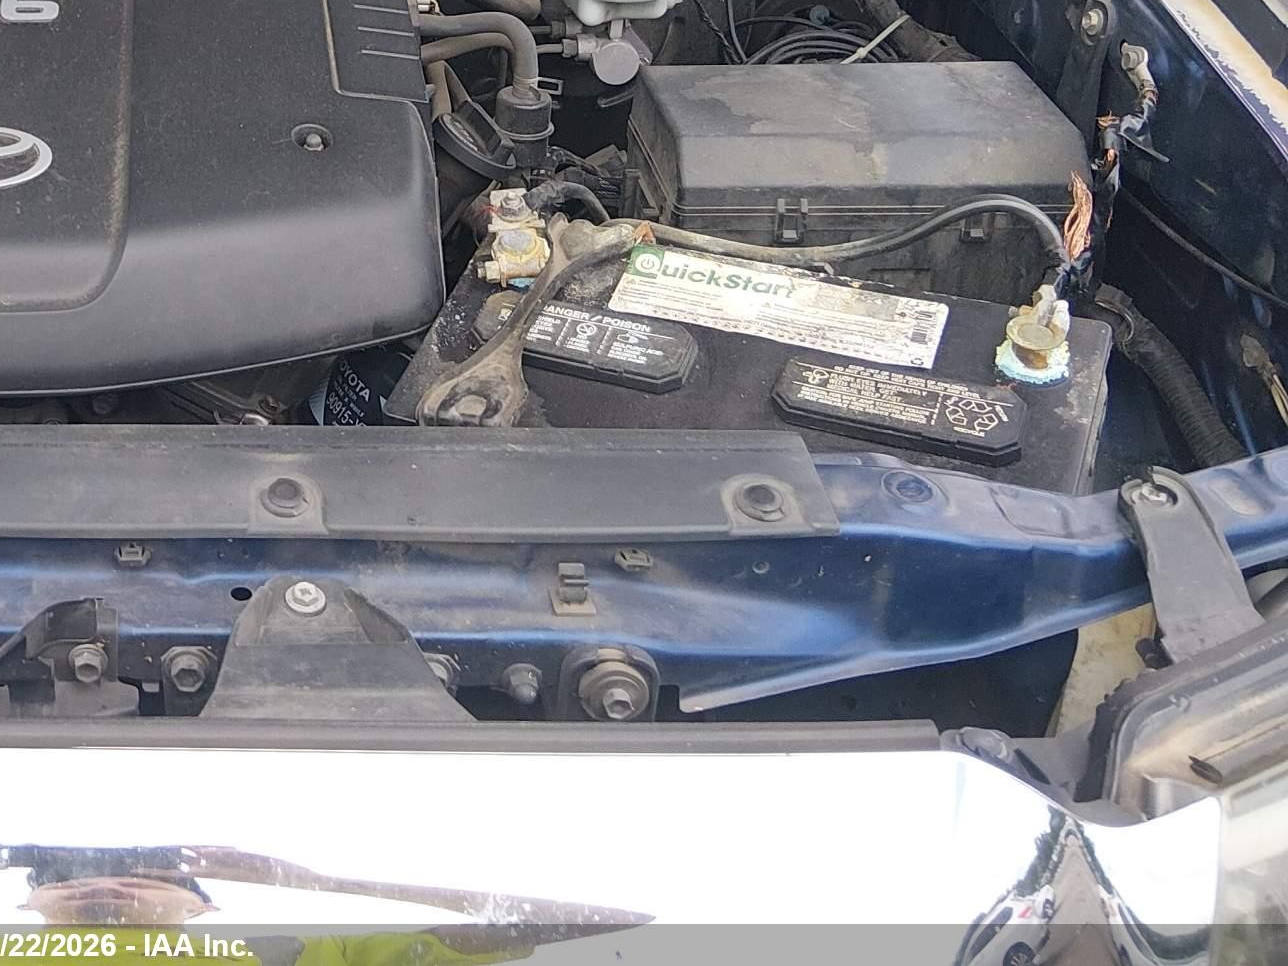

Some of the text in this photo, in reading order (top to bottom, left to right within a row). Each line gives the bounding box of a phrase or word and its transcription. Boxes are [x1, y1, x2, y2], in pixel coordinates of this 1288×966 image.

[634, 252, 795, 298] QuickStart
[602, 316, 651, 333] POISON
[340, 360, 370, 402] OYOTA
